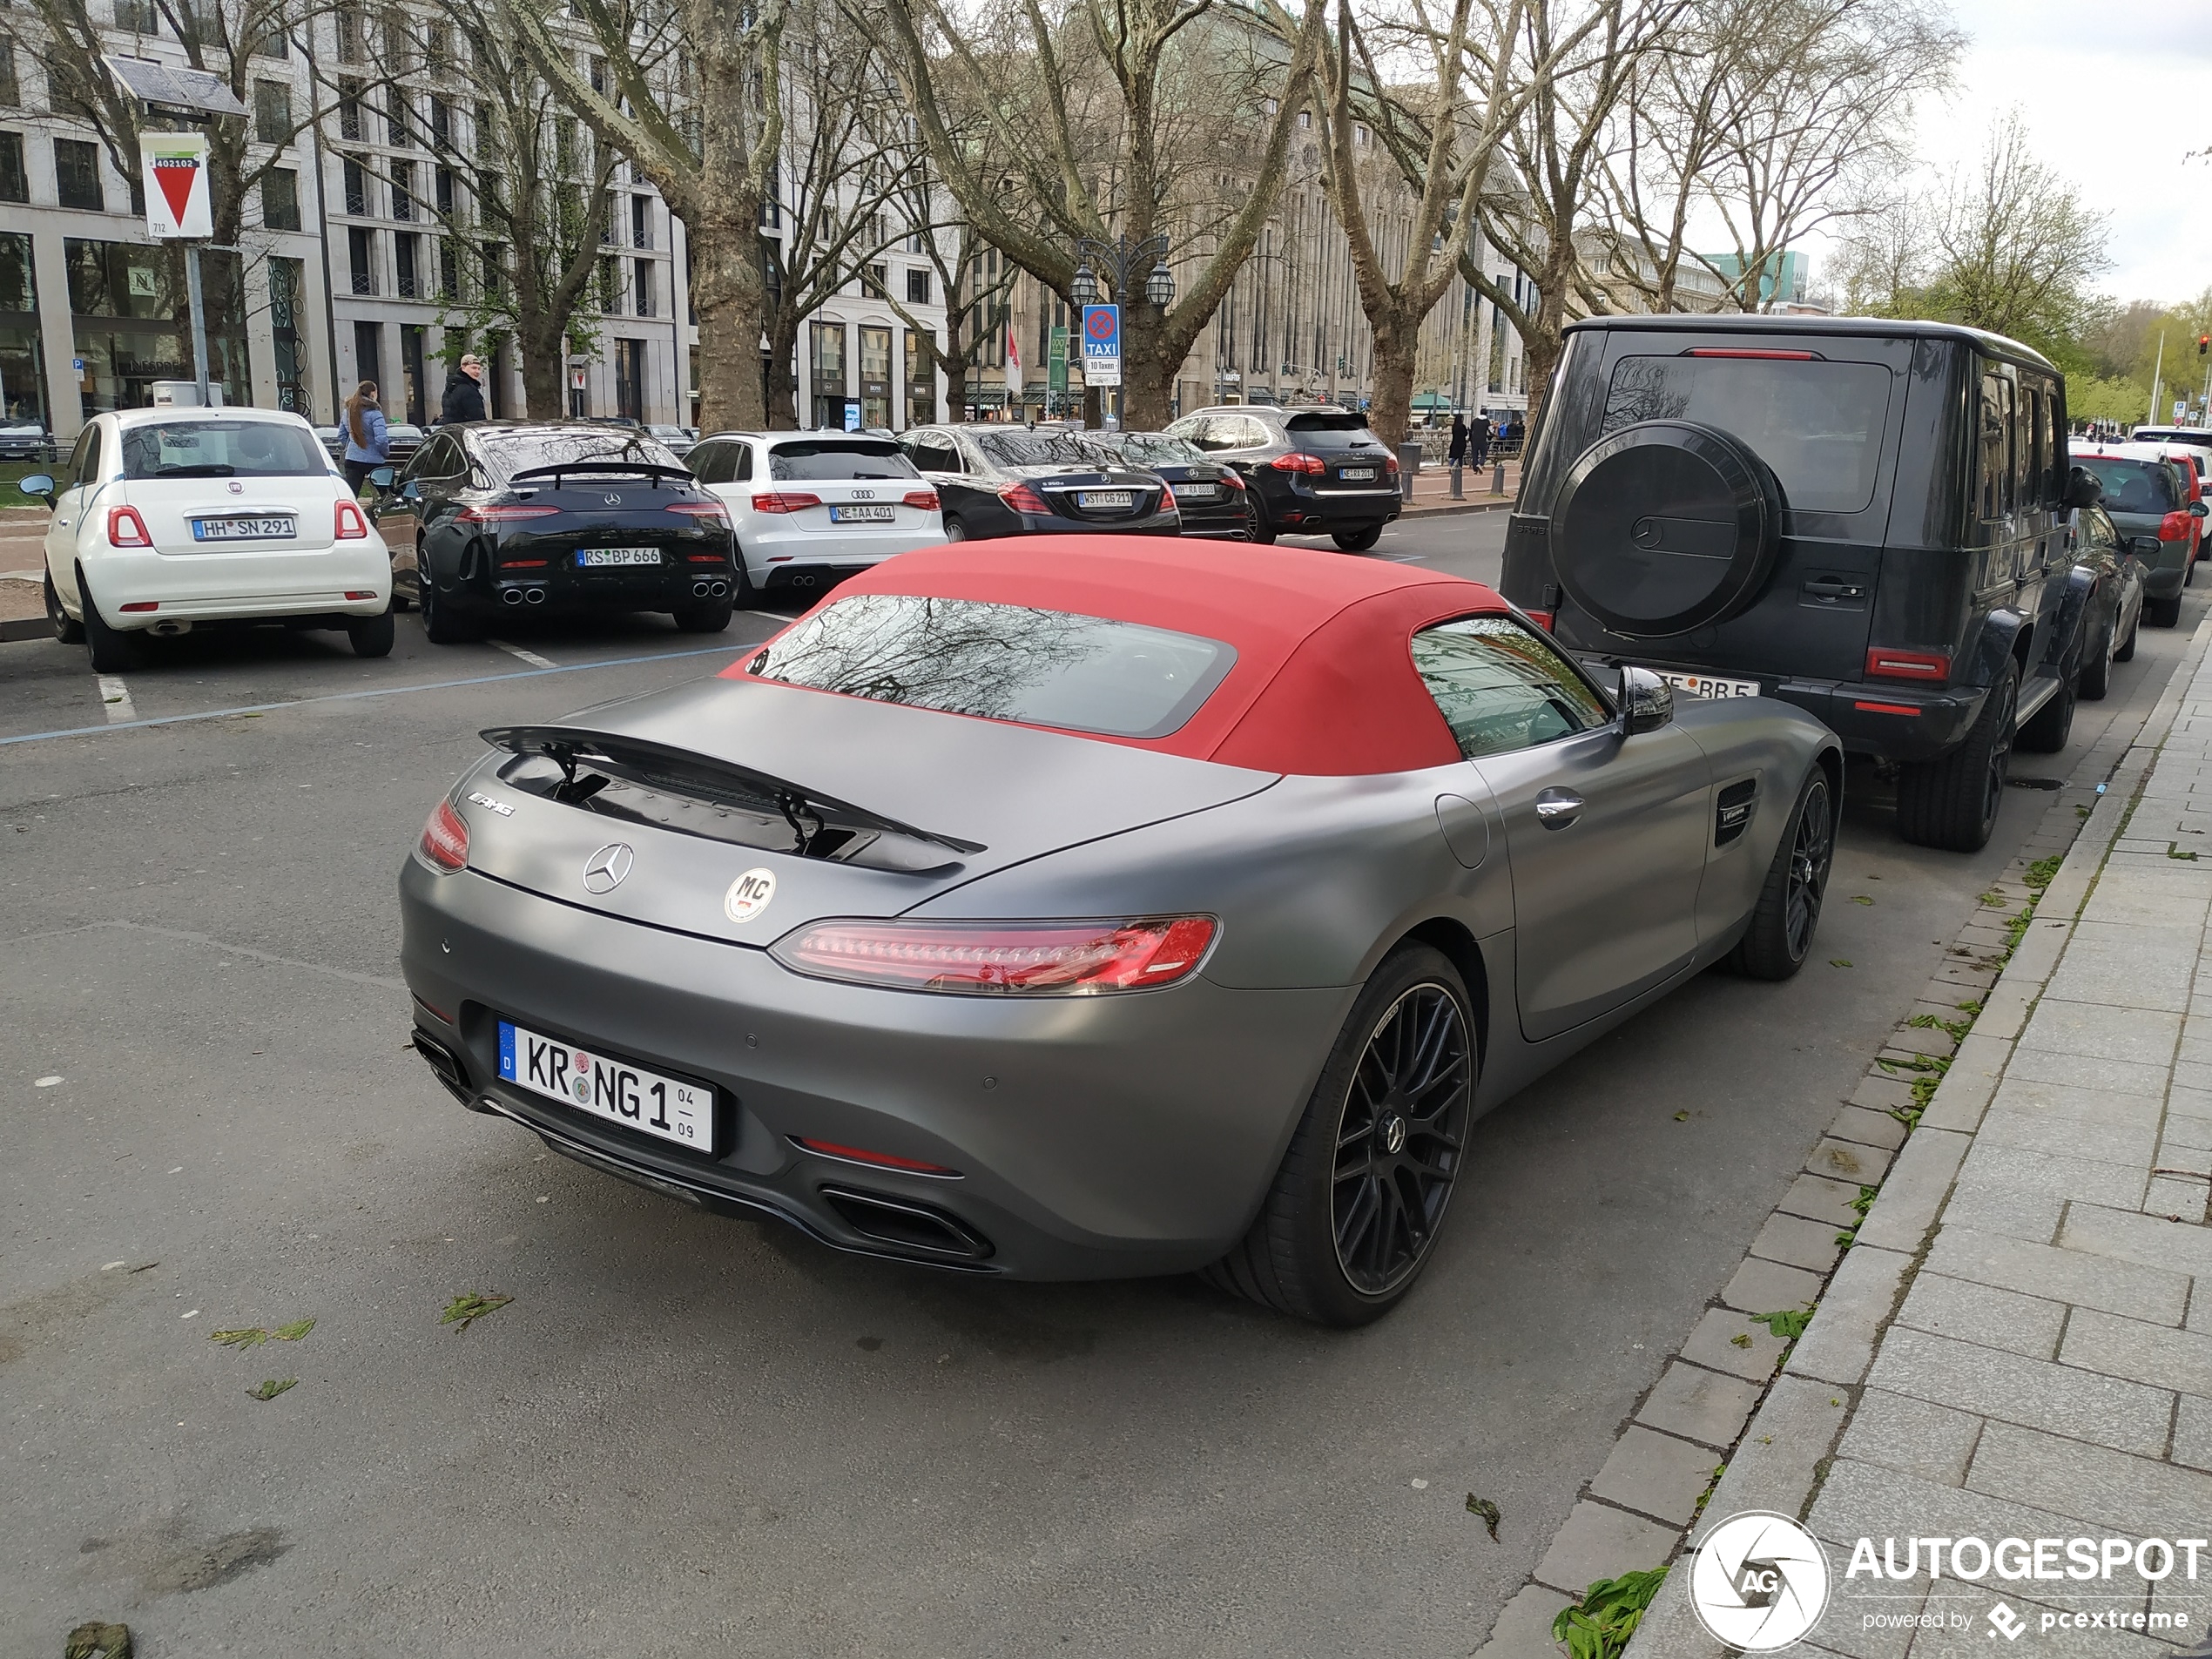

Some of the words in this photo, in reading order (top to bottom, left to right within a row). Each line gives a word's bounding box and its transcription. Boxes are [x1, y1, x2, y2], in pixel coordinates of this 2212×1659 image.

[153, 223, 166, 233] 712
[1087, 343, 1116, 355] TAXI
[1084, 493, 1100, 503] WST
[1104, 493, 1116, 502] CG
[1116, 493, 1130, 502] 211
[837, 508, 852, 518] NE
[859, 508, 872, 518] AA
[873, 507, 893, 517] 401
[204, 522, 227, 536] HH
[238, 521, 260, 534] SN
[262, 520, 293, 534] 291
[585, 550, 604, 563] RS
[612, 550, 630, 563] BP
[633, 550, 658, 563] 666
[736, 875, 771, 900] MC
[503, 1055, 511, 1070] D
[528, 1036, 570, 1096] KR
[595, 1060, 640, 1122] NG
[650, 1082, 671, 1131] 1
[678, 1089, 693, 1105] 04
[678, 1122, 693, 1138] 09
